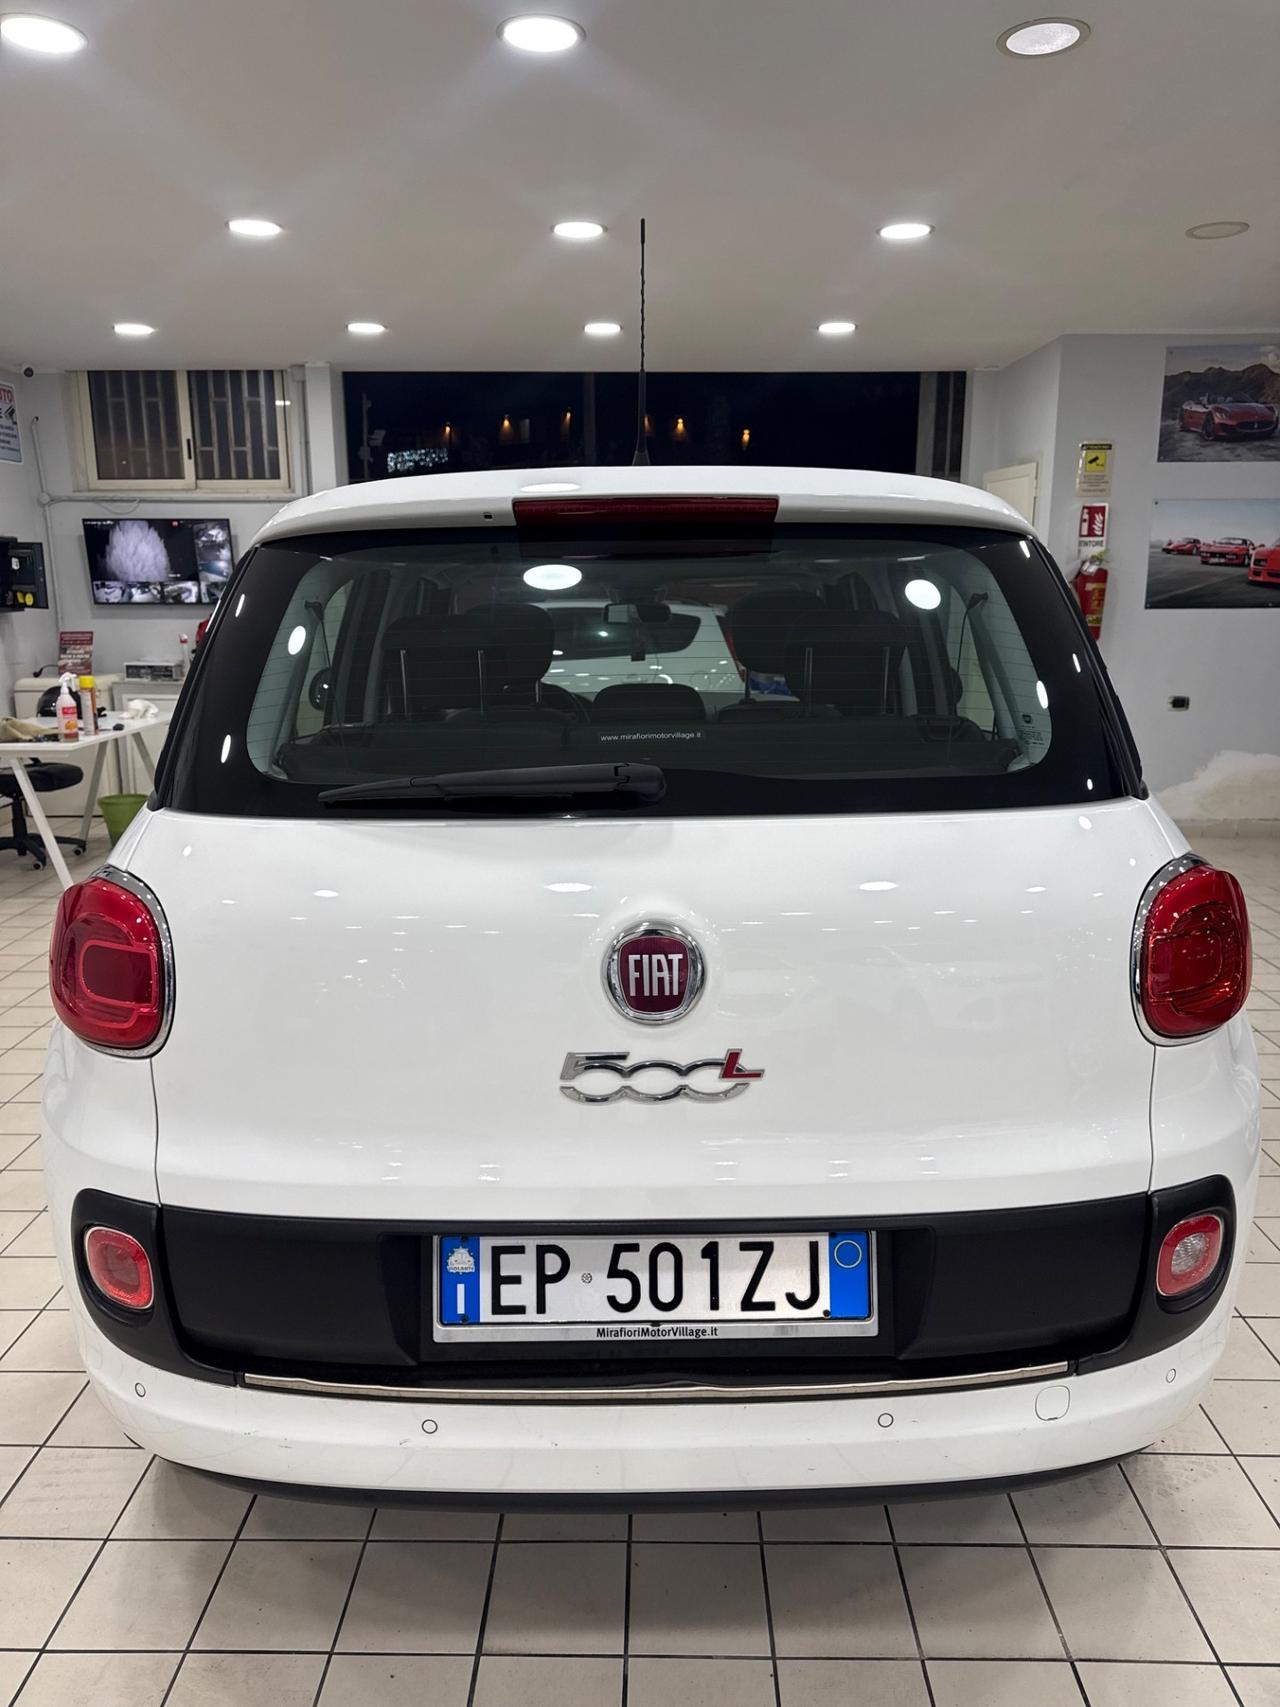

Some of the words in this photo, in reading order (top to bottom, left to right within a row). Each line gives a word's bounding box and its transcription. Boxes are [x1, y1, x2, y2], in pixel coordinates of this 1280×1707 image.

[600, 732, 701, 741] www.mirafiorimotorvillage.it
[628, 954, 683, 997] FIAT
[560, 1048, 765, 1105] 500L
[491, 1243, 571, 1316] EP
[606, 1240, 820, 1313] 501ZJ
[457, 1283, 465, 1314] I
[596, 1326, 718, 1338] MirafioriMotorVillage.it
